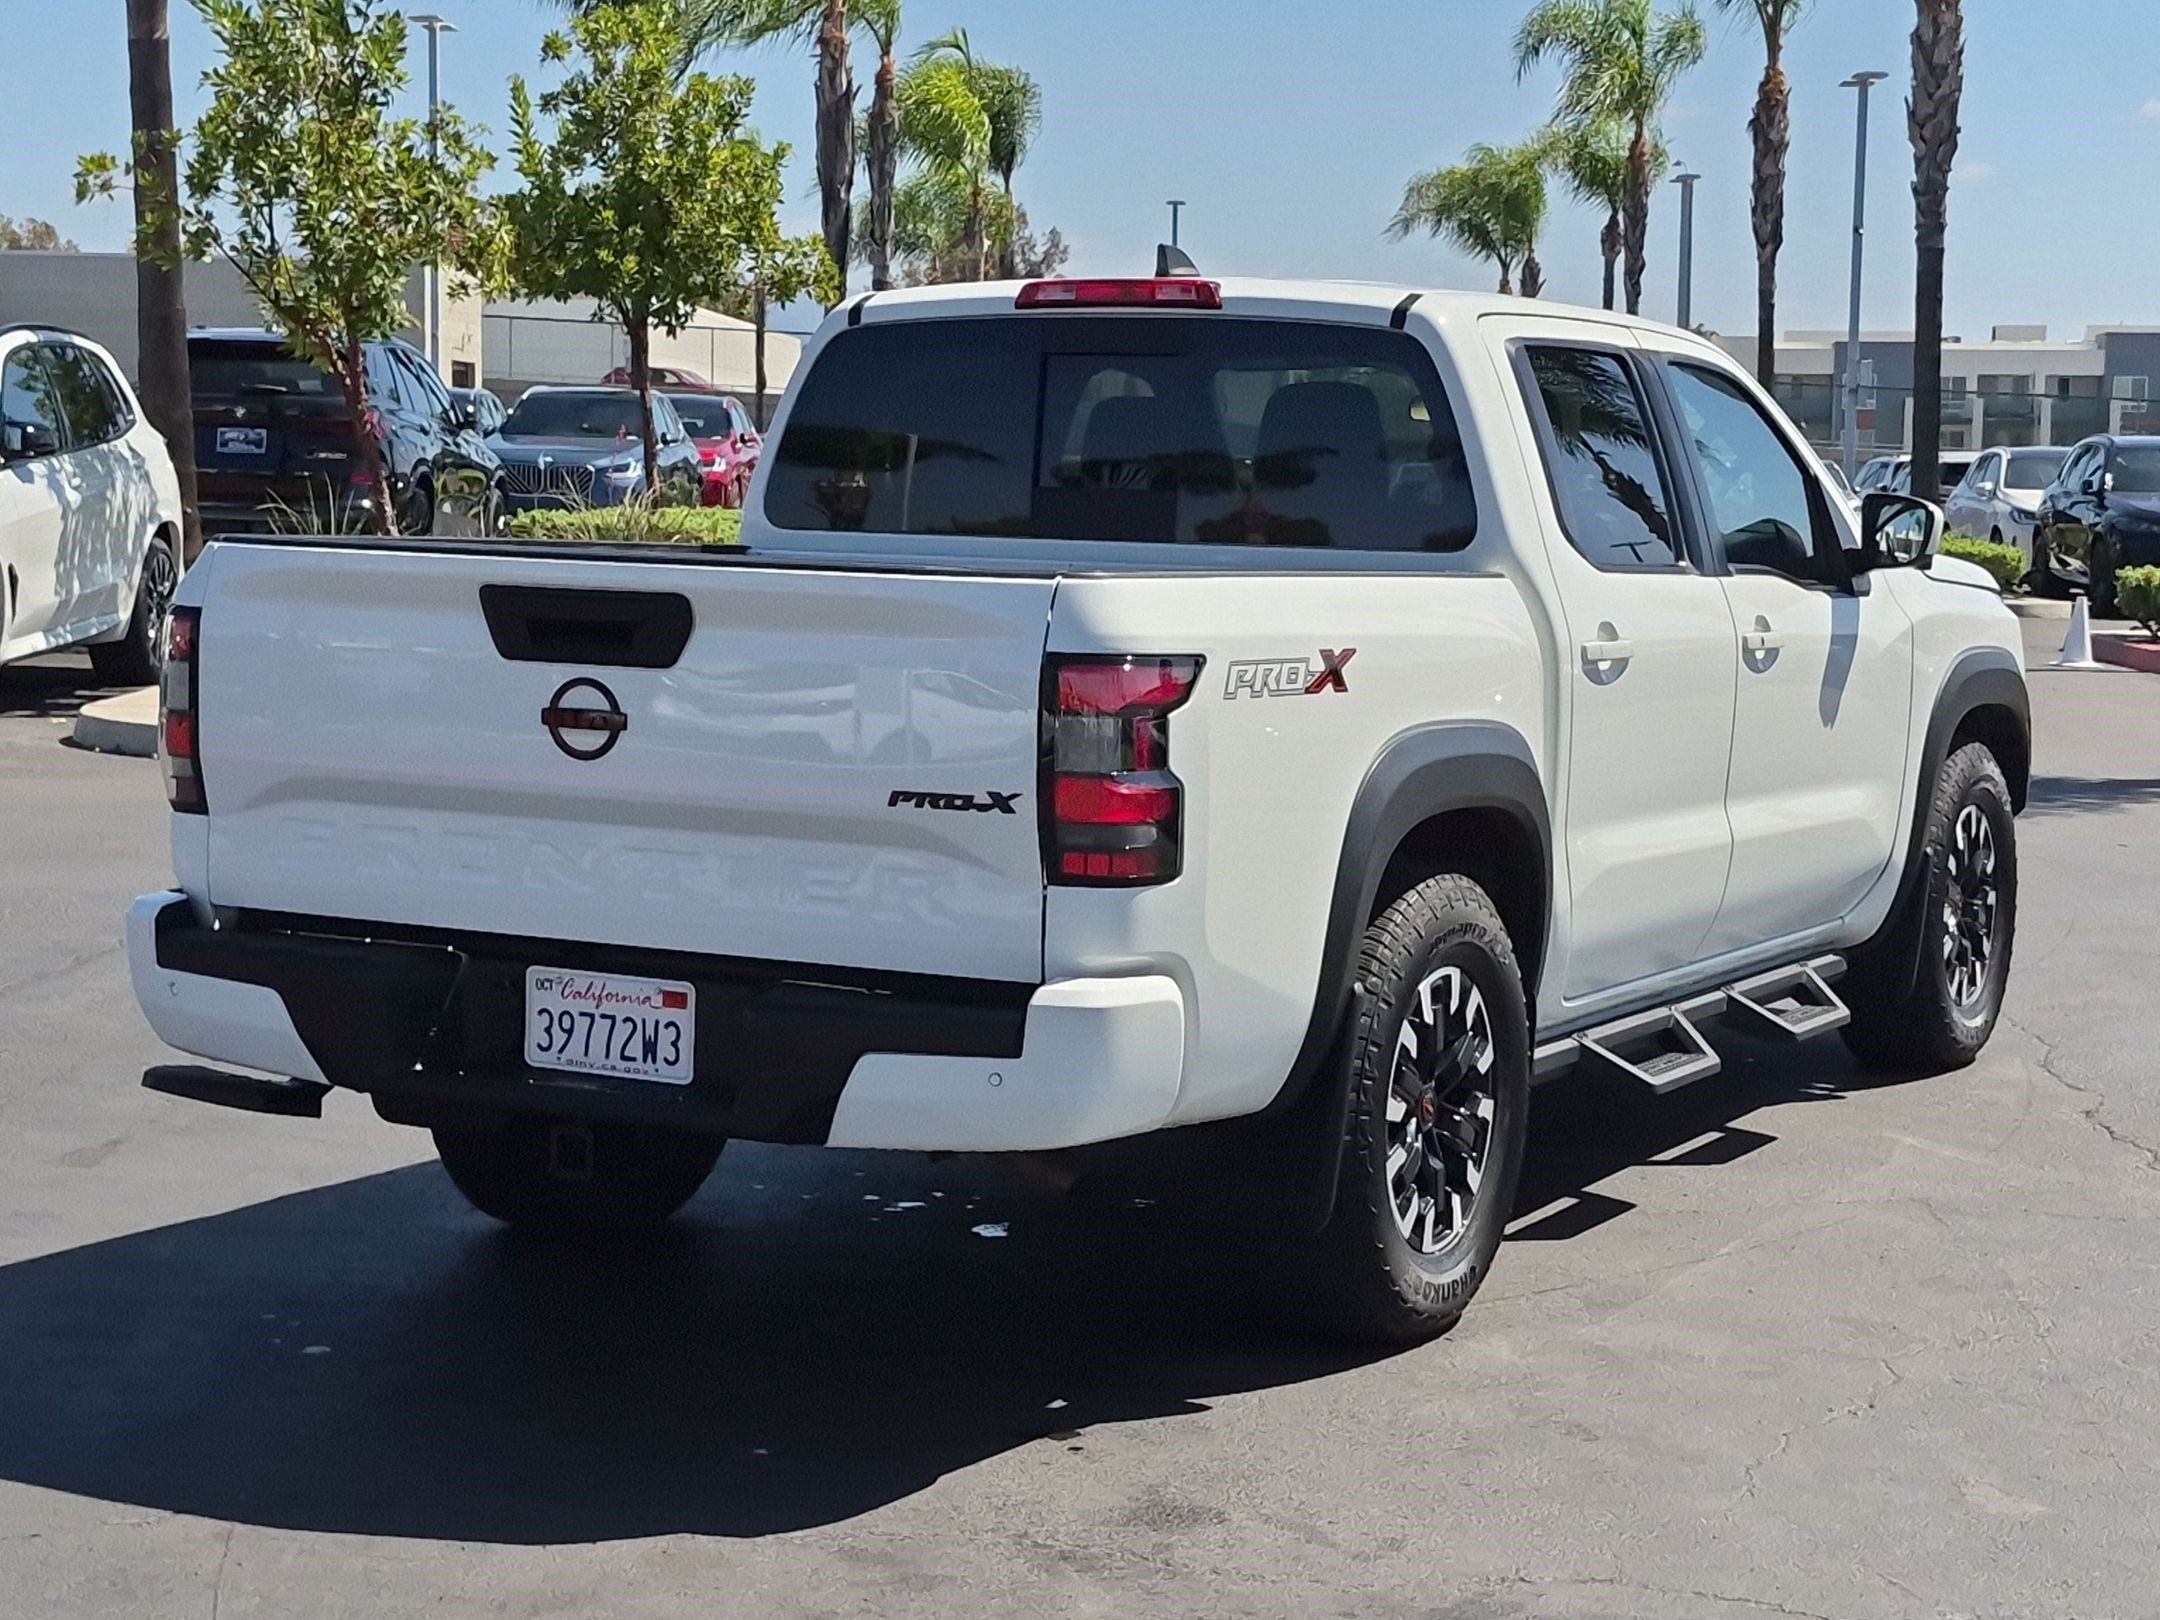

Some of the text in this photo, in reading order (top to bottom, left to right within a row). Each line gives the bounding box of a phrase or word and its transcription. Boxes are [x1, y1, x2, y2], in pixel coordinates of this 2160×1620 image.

[1223, 649, 1357, 700] PRO-X
[535, 978, 554, 991] OCT
[561, 977, 652, 1010] California
[536, 1007, 682, 1067] 39772W3
